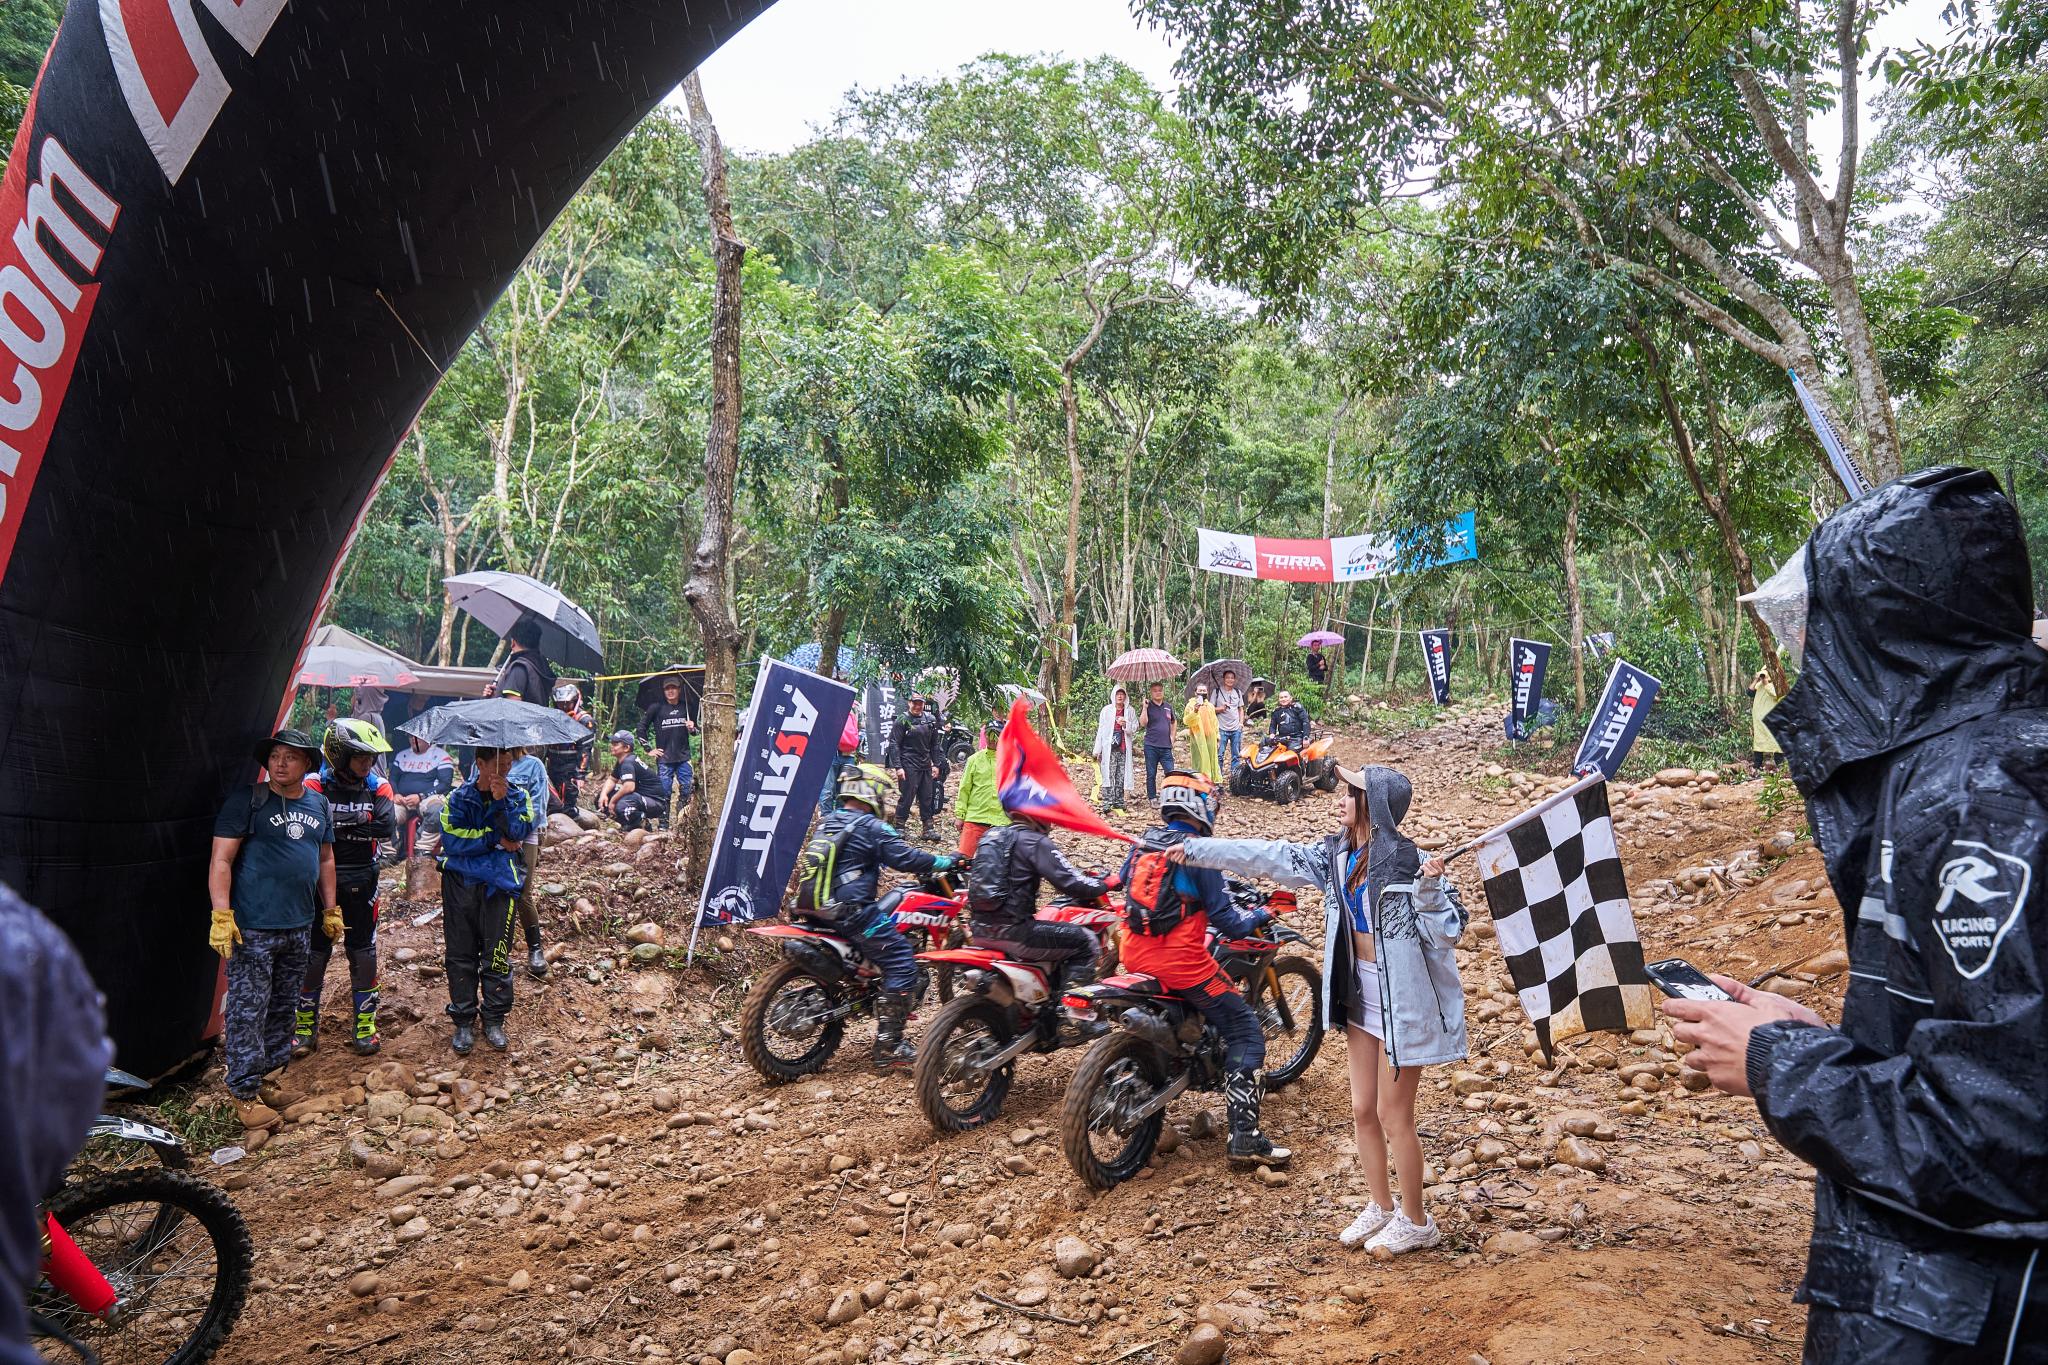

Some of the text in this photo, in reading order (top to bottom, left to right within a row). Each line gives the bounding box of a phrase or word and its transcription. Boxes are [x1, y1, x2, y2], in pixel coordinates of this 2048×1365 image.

[1261, 553, 1326, 568] TORRA
[269, 811, 320, 830] CHAMPION
[896, 911, 950, 927] MOTUL
[1941, 917, 1997, 934] RACING
[1950, 935, 1992, 948] SPORTS
